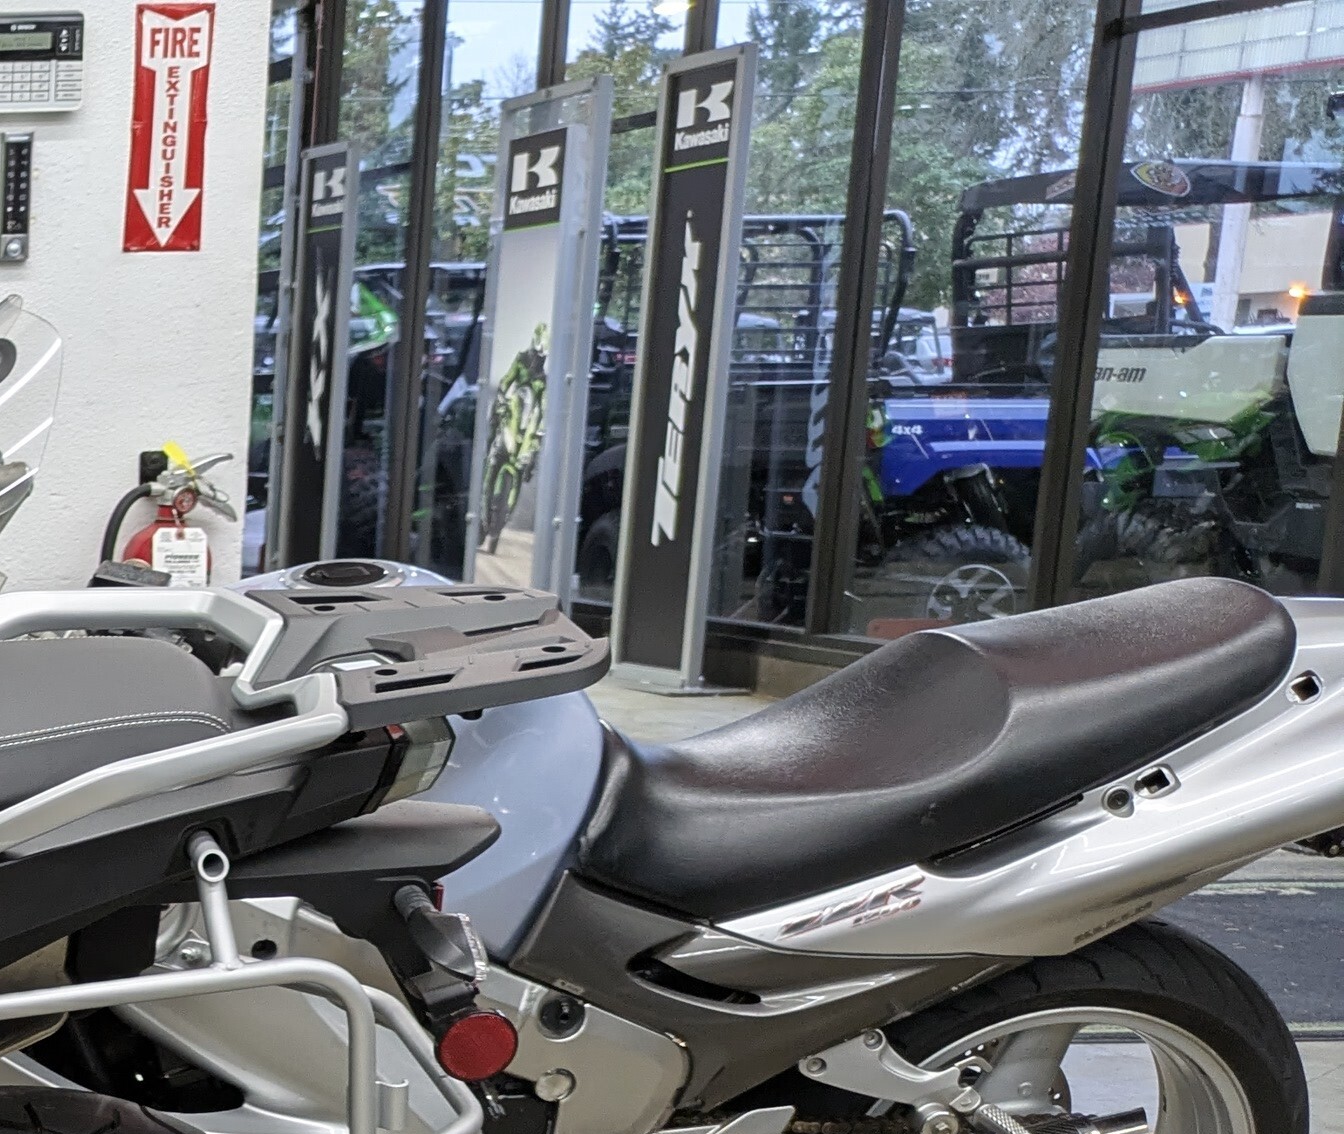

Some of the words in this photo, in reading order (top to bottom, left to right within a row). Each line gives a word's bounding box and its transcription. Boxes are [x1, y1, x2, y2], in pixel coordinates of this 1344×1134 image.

[150, 27, 202, 59] FIRE
[157, 66, 180, 229] EXTINGUISHER
[674, 123, 730, 151] Kawasaki
[509, 188, 557, 215] Kawasaki
[651, 220, 701, 546] TERYX
[1094, 366, 1147, 384] an-am
[892, 425, 923, 435] 4x4
